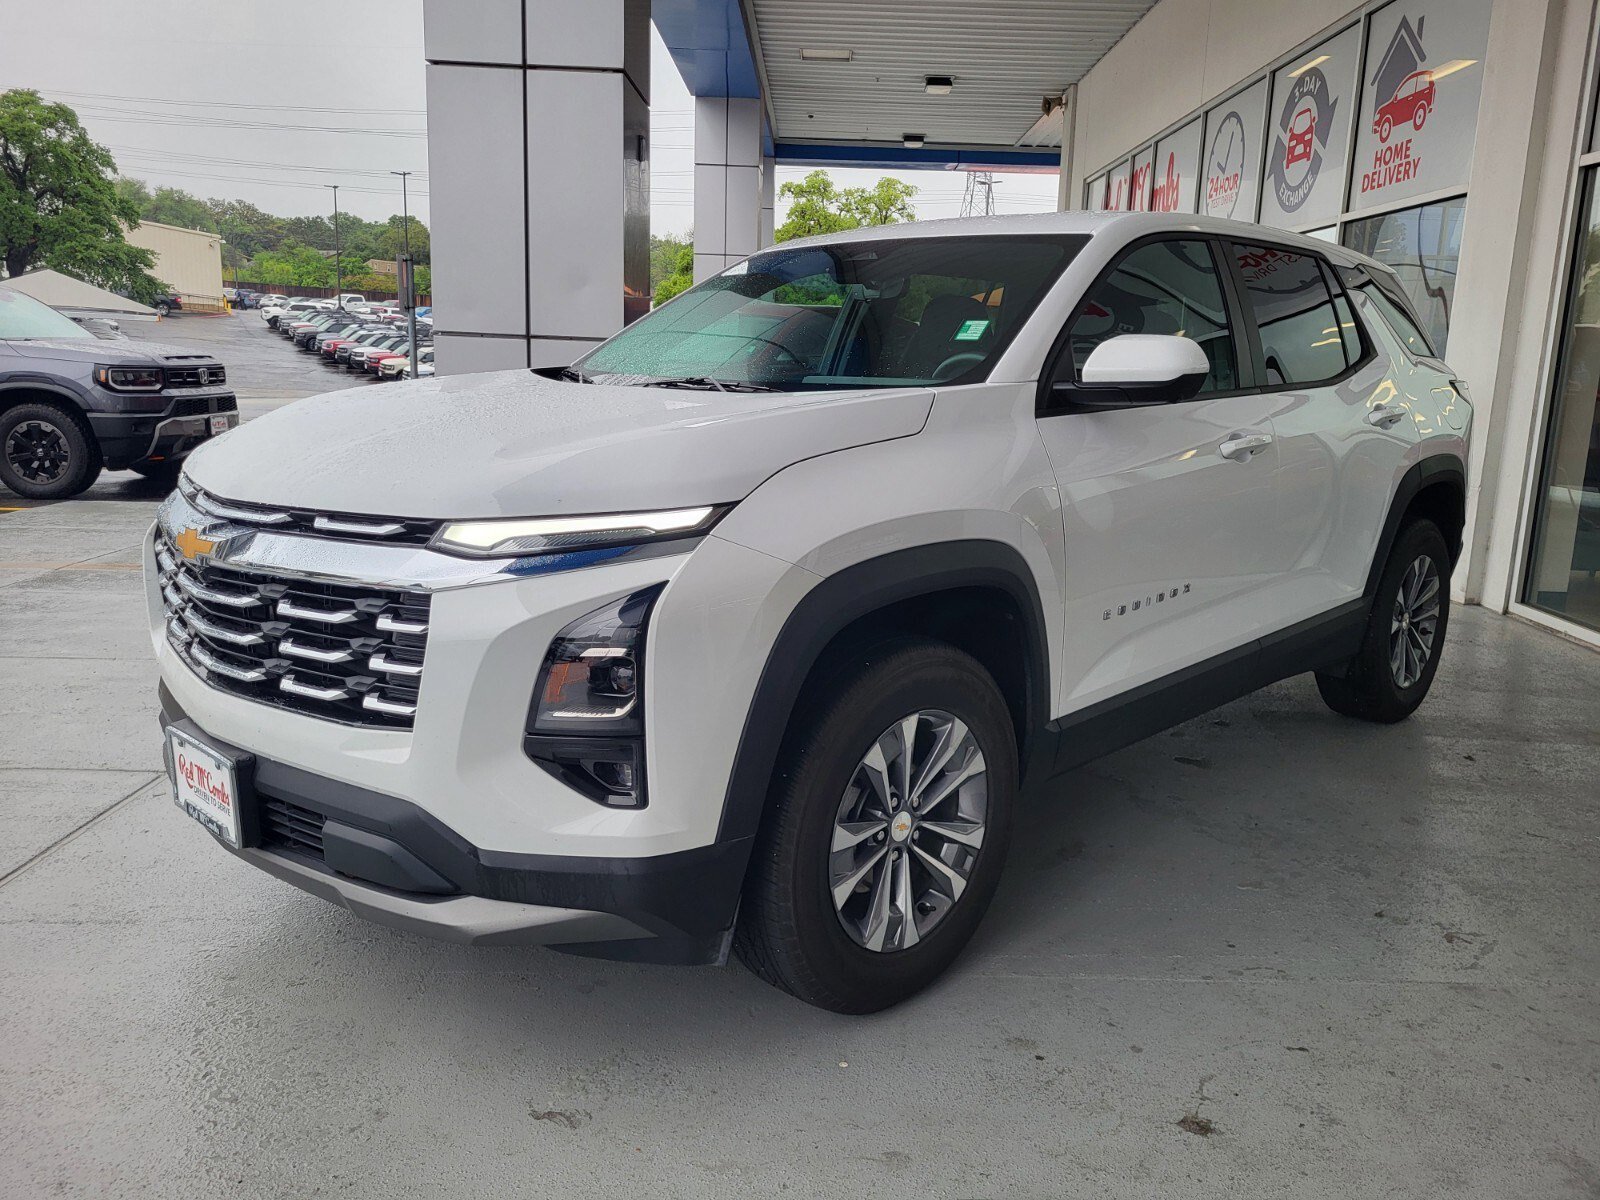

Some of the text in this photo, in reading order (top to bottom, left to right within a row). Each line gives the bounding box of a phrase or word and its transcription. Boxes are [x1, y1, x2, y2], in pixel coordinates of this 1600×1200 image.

[1374, 138, 1412, 169] HOME
[1208, 172, 1239, 200] 24 HOUR
[1279, 173, 1314, 206] EXCHANGE
[1361, 156, 1421, 193] DELIVERY
[1103, 583, 1191, 620] EQUINOX
[179, 753, 196, 789] Red
[210, 795, 217, 806] TO
